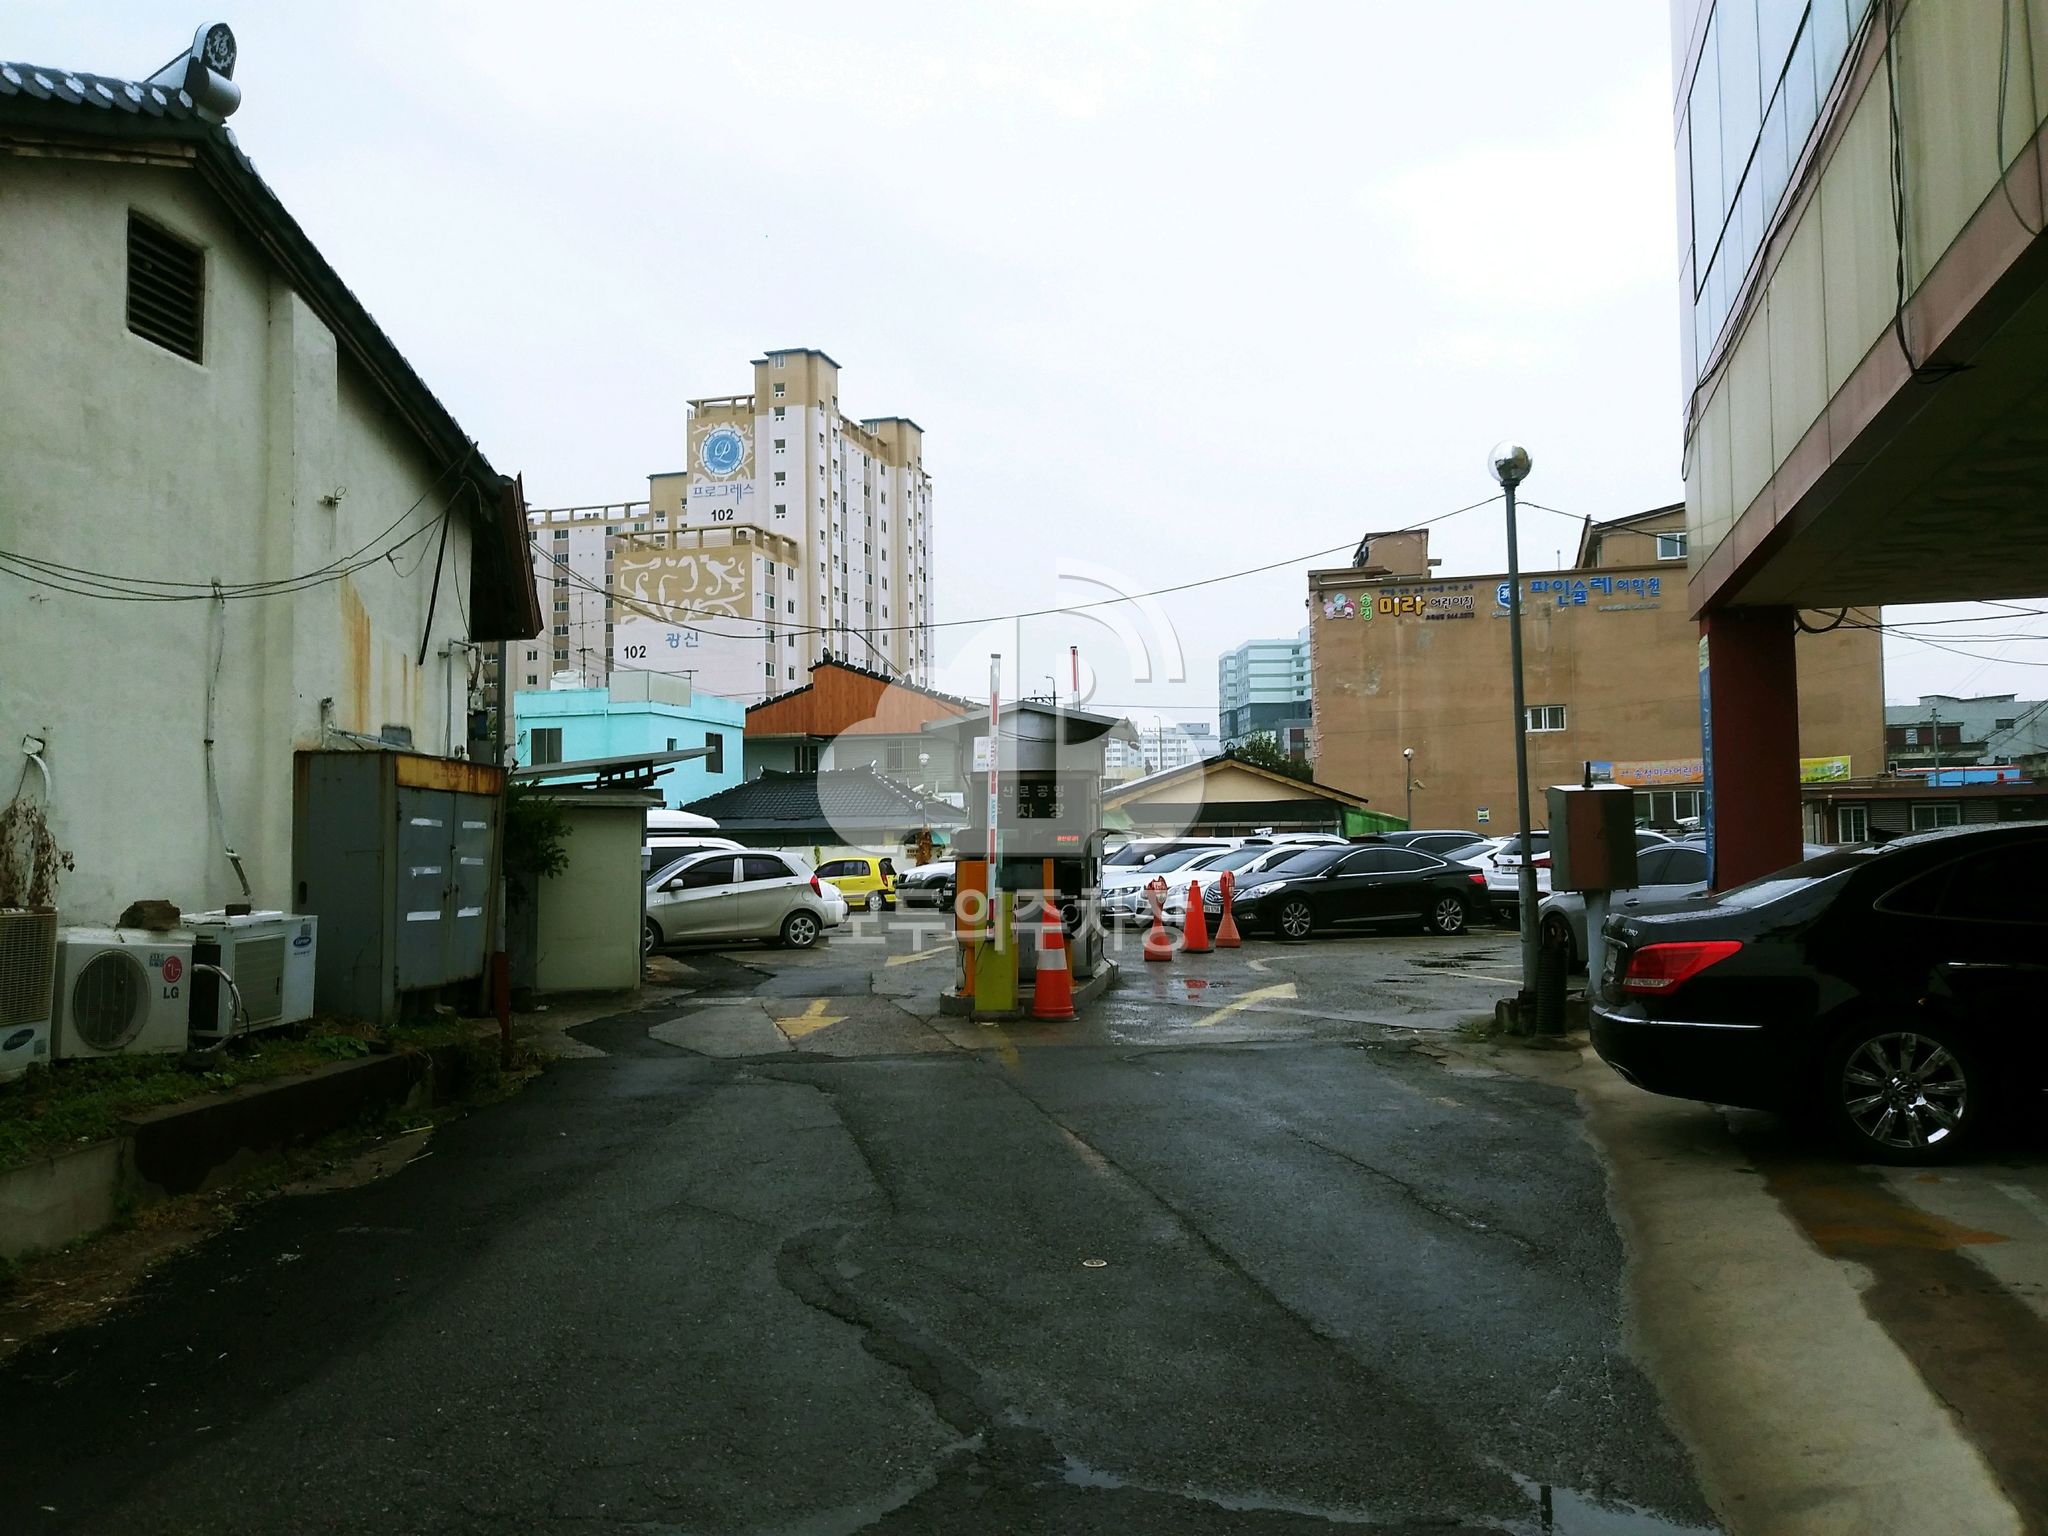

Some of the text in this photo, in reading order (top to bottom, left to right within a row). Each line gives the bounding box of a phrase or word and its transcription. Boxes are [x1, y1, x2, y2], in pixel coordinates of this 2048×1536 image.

[692, 483, 755, 505] 프로그레스
[711, 509, 734, 522] 102
[1616, 576, 1661, 600] 어학원
[1359, 592, 1474, 622] 송정 미라 어린이집
[665, 632, 699, 649] 광신
[623, 645, 647, 659] 102
[1633, 763, 1703, 780] 송정미라어린이
[163, 986, 179, 999] LG
